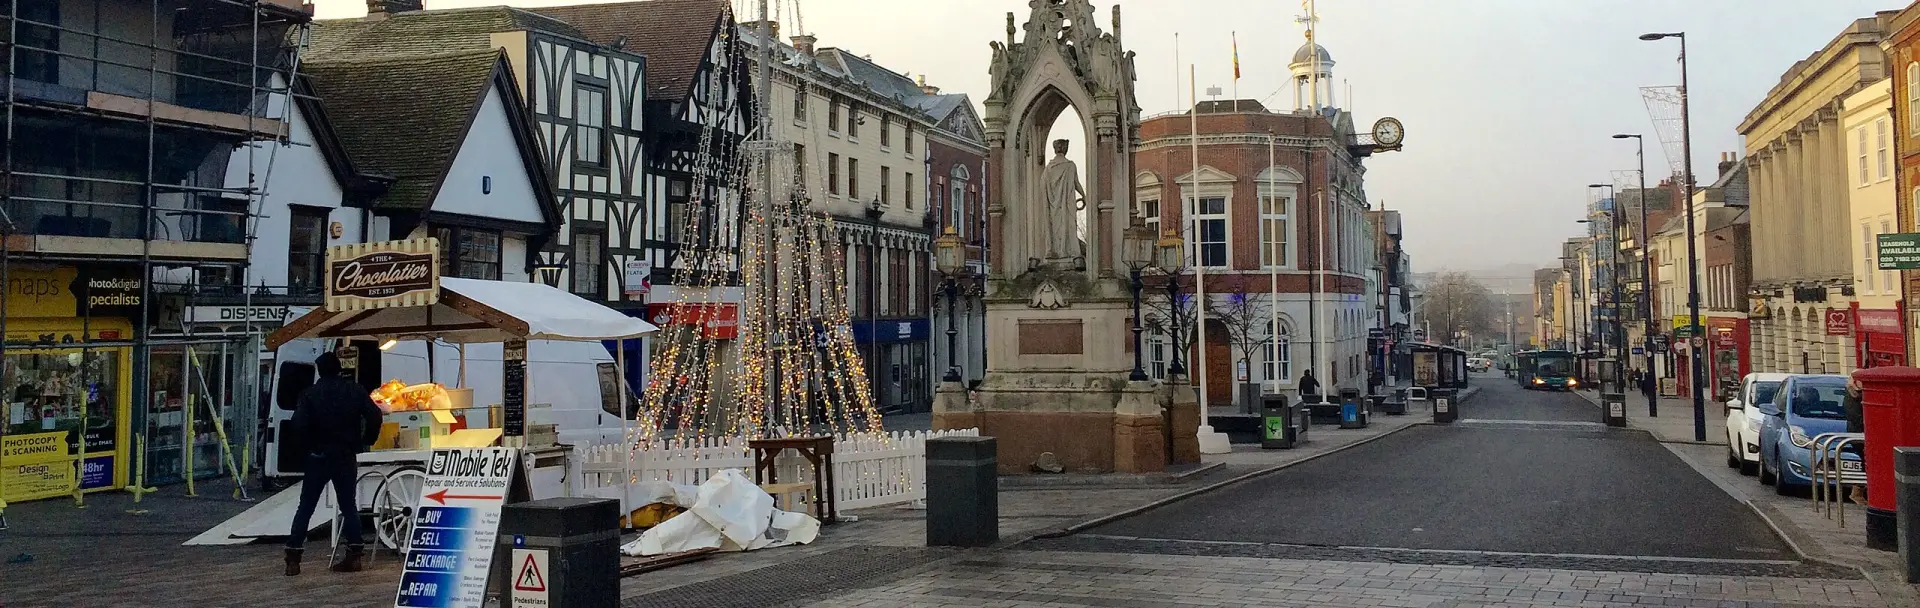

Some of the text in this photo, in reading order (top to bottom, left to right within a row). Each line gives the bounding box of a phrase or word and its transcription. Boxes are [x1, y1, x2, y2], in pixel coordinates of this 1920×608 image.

[336, 261, 428, 292] Chocolatier
[89, 278, 141, 291] hoto&digital
[89, 293, 141, 309] pecialists
[4, 436, 57, 448] PHOTOCOPY
[4, 445, 57, 456] & SCANNING
[19, 465, 49, 476] Design
[445, 449, 511, 478] Mobile Tek
[424, 478, 506, 489] Repair and Service Solutions
[424, 510, 442, 524] BUY
[420, 531, 440, 546] SELL
[407, 553, 457, 571] we EXCHANGE
[400, 581, 438, 597] we REPAIR
[514, 596, 547, 605] Pedestrians
